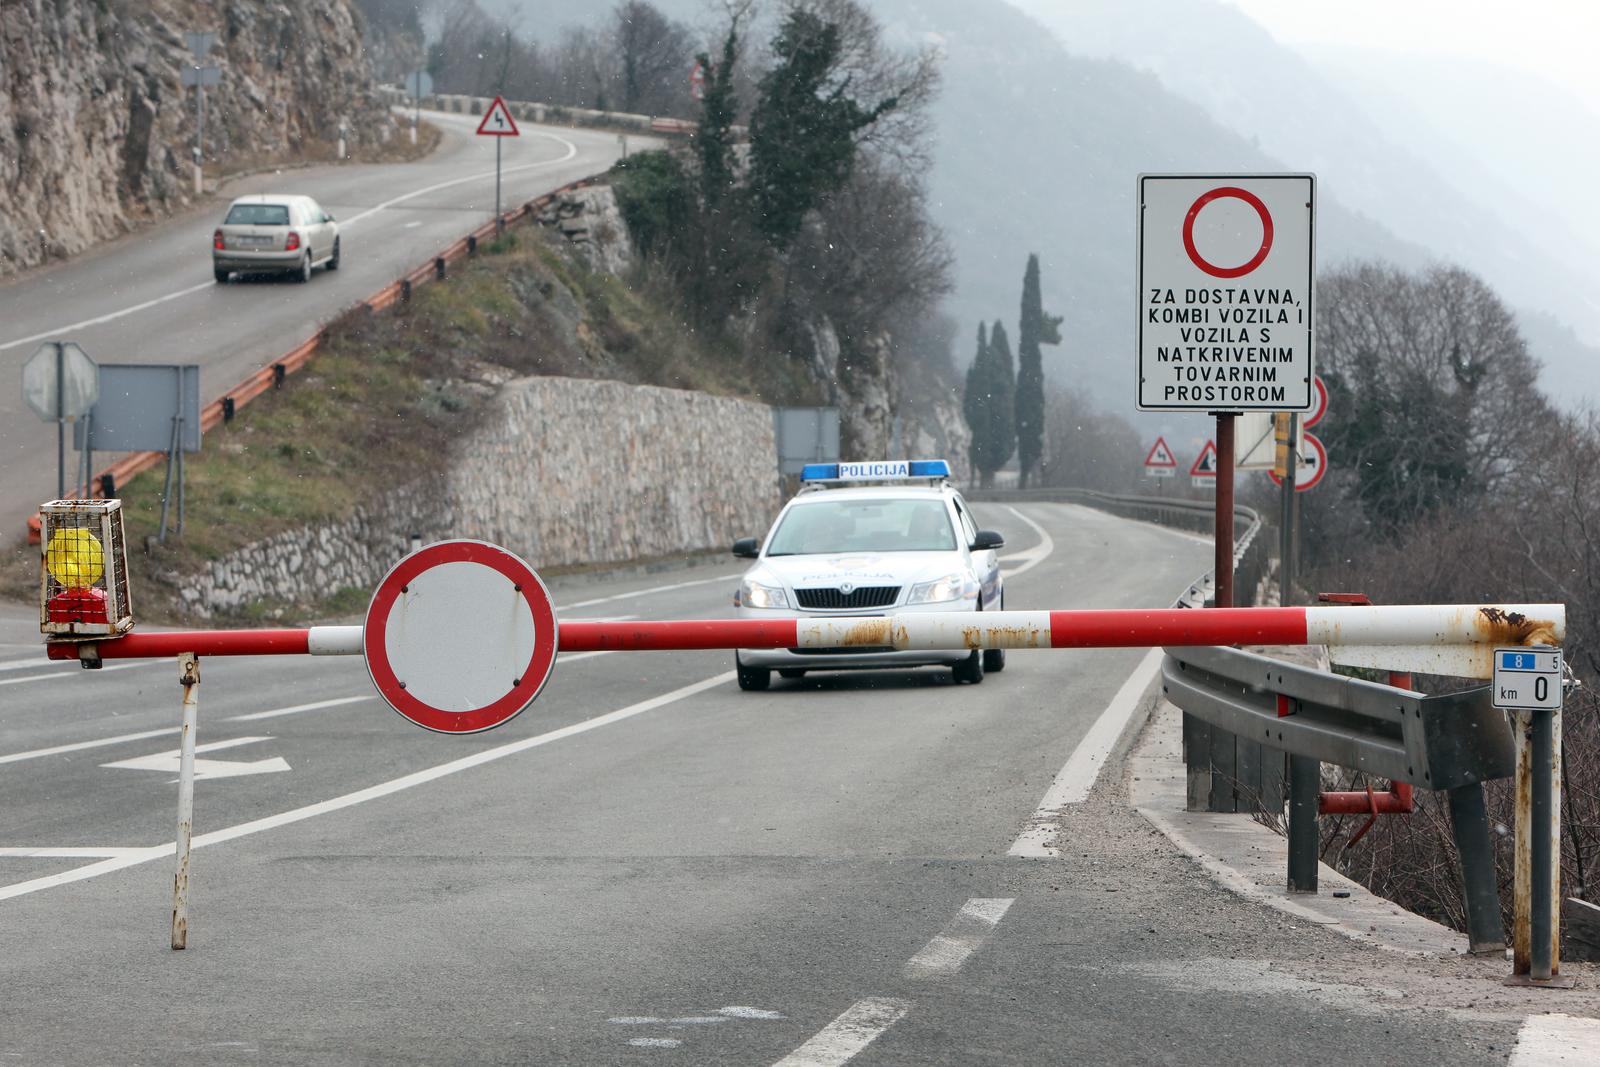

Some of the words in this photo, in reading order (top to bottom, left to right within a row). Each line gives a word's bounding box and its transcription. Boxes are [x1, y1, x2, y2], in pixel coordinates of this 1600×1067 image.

[1150, 288, 1176, 304] ZA
[1185, 288, 1301, 307] DOSTAVNA,
[1149, 308, 1209, 324] KOMBI
[1218, 308, 1289, 324] VOZILA
[1298, 309, 1303, 324] I
[1180, 327, 1250, 343] VOZILA
[1259, 327, 1271, 343] S
[1157, 347, 1293, 363] NATKRIVENIM
[1173, 366, 1277, 382] TOVARNIM
[1164, 386, 1285, 401] PROSTOROM
[840, 464, 907, 477] POLICIJA
[1515, 654, 1523, 668] 8
[1552, 656, 1558, 670] 5
[1500, 686, 1518, 700] km
[1534, 676, 1548, 702] 0
